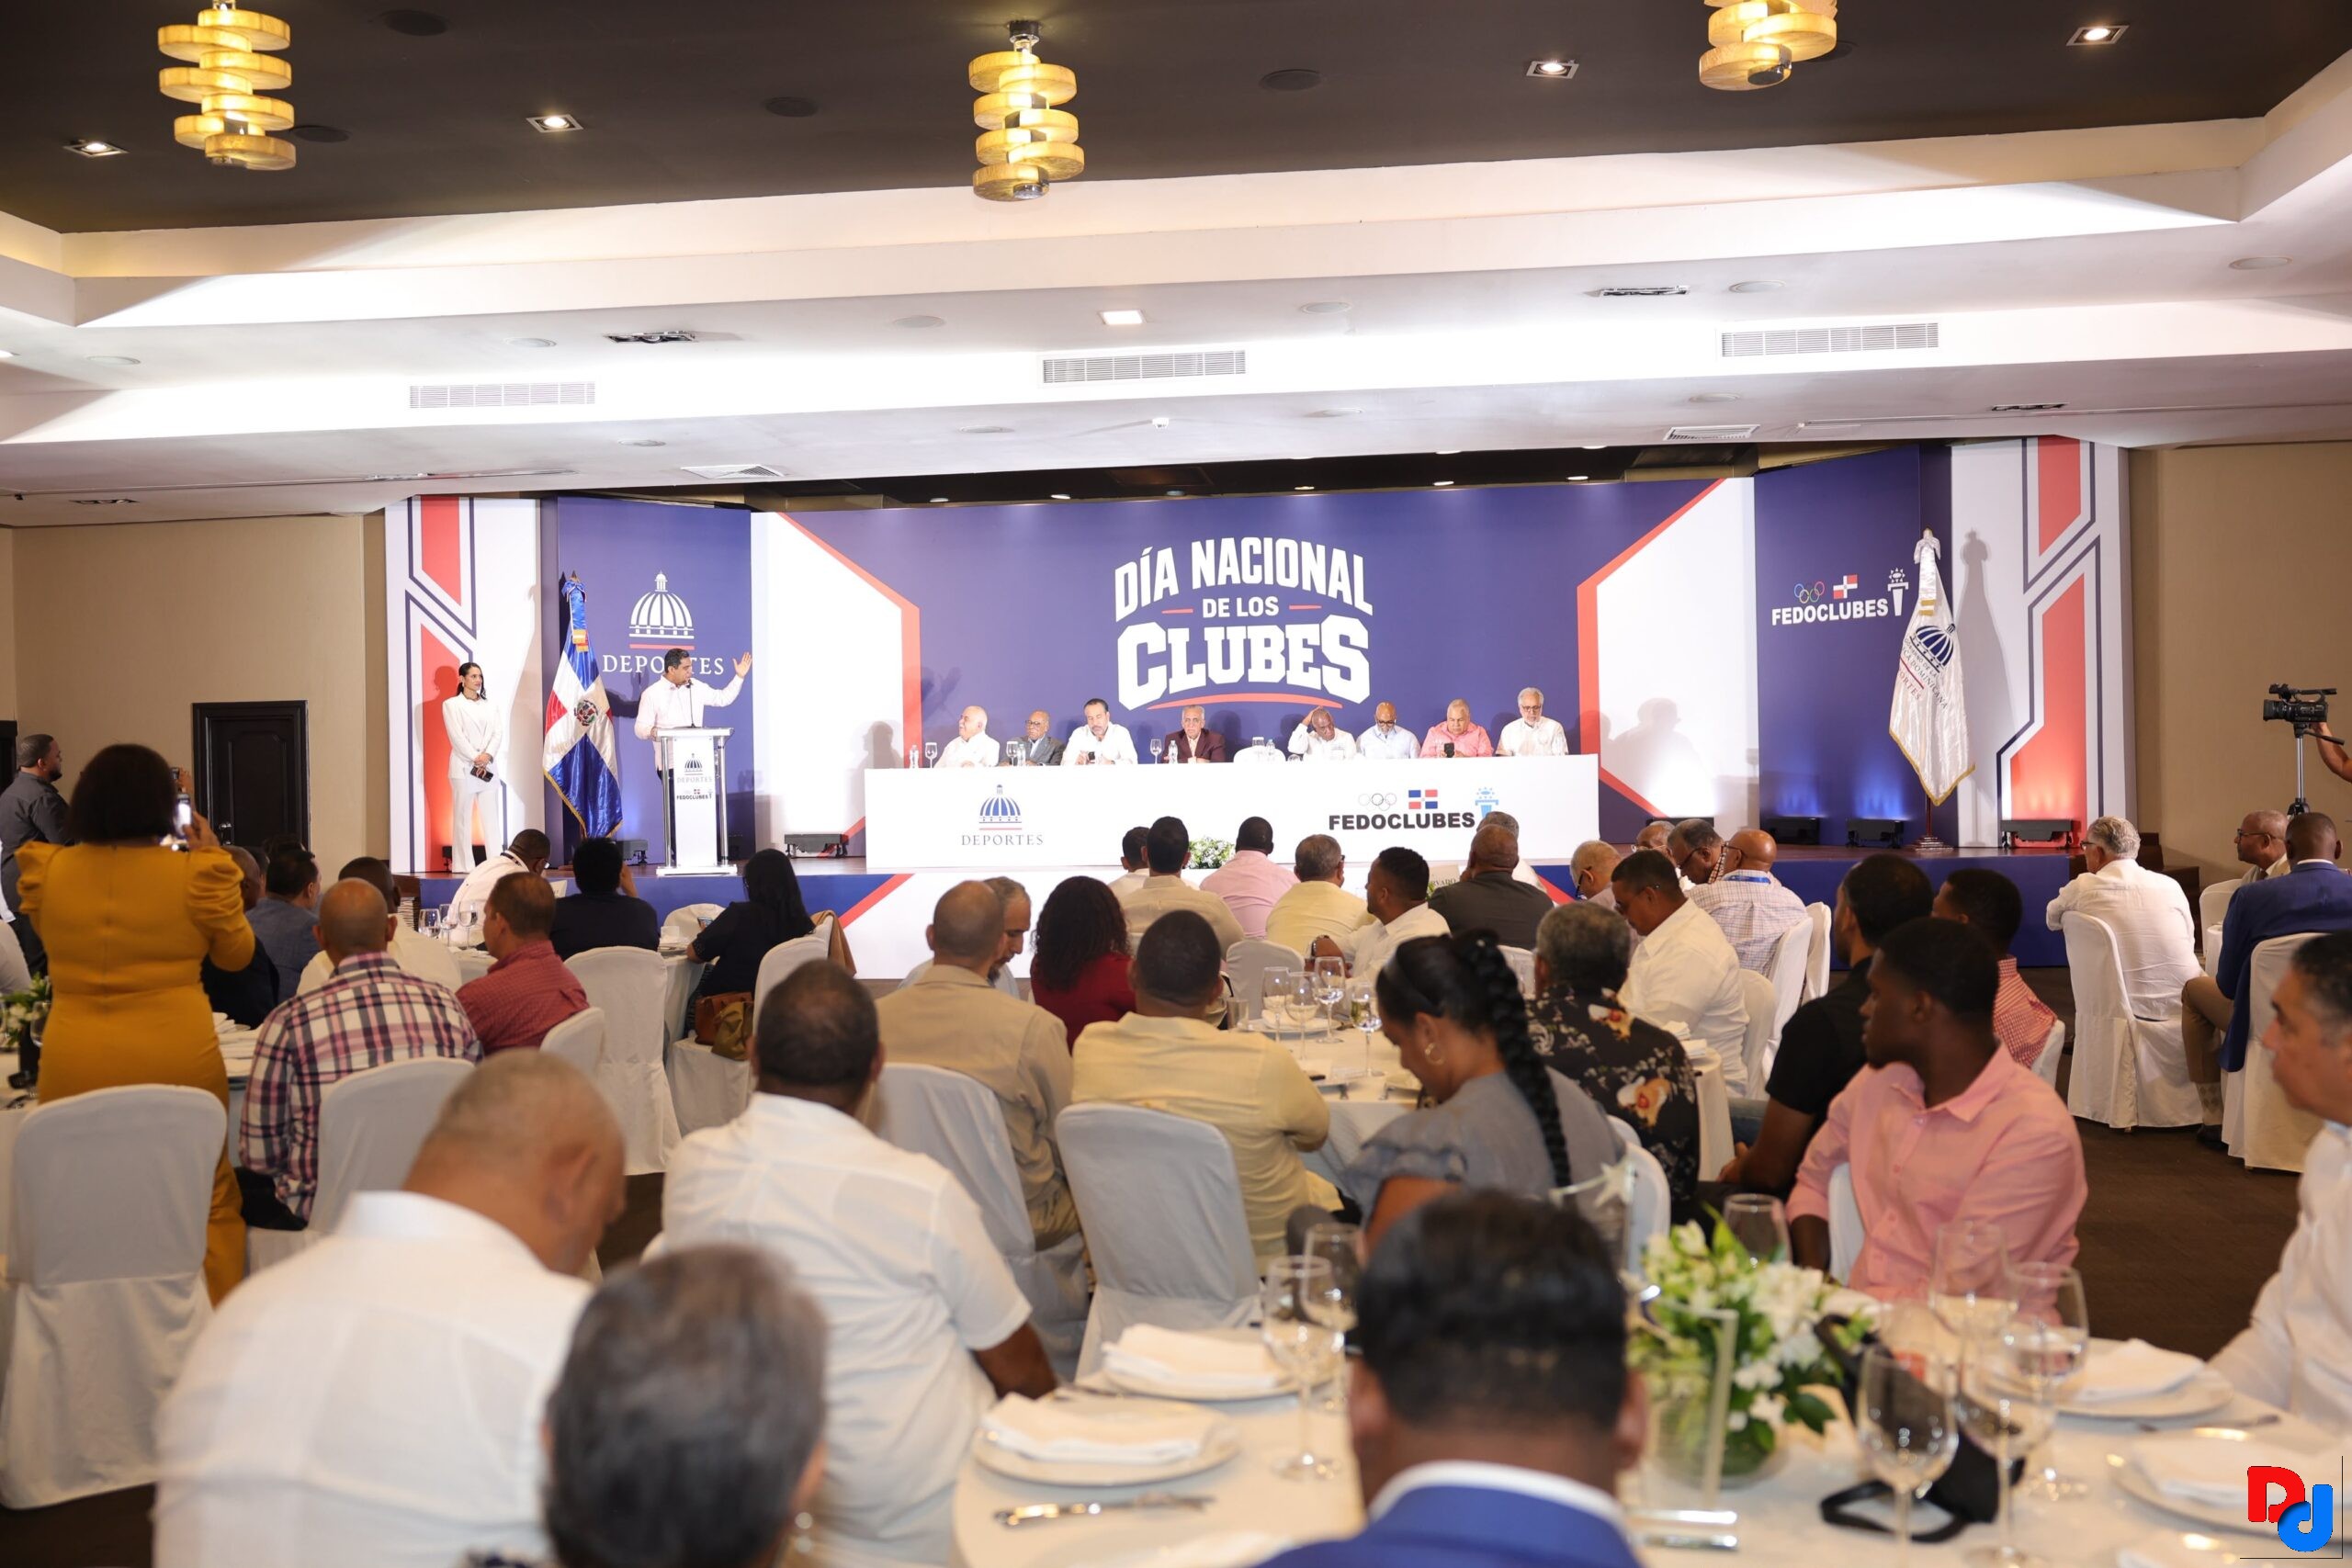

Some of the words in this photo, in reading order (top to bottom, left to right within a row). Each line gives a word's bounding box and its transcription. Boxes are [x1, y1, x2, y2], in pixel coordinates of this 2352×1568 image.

[1114, 546, 1180, 623] DÍA
[1191, 536, 1374, 616] NACIONAL
[1202, 597, 1230, 618] DE
[1236, 595, 1280, 617] LOS
[1771, 598, 1889, 626] FEDOCLUBES
[602, 654, 725, 675] DEPOTES
[1117, 614, 1371, 712] CLUBES
[1898, 671, 1922, 701] ORTES
[1911, 660, 1949, 710] DOMINICANA
[1329, 812, 1476, 830] FEDOCLUBES
[961, 834, 1044, 846] DEPORTES
